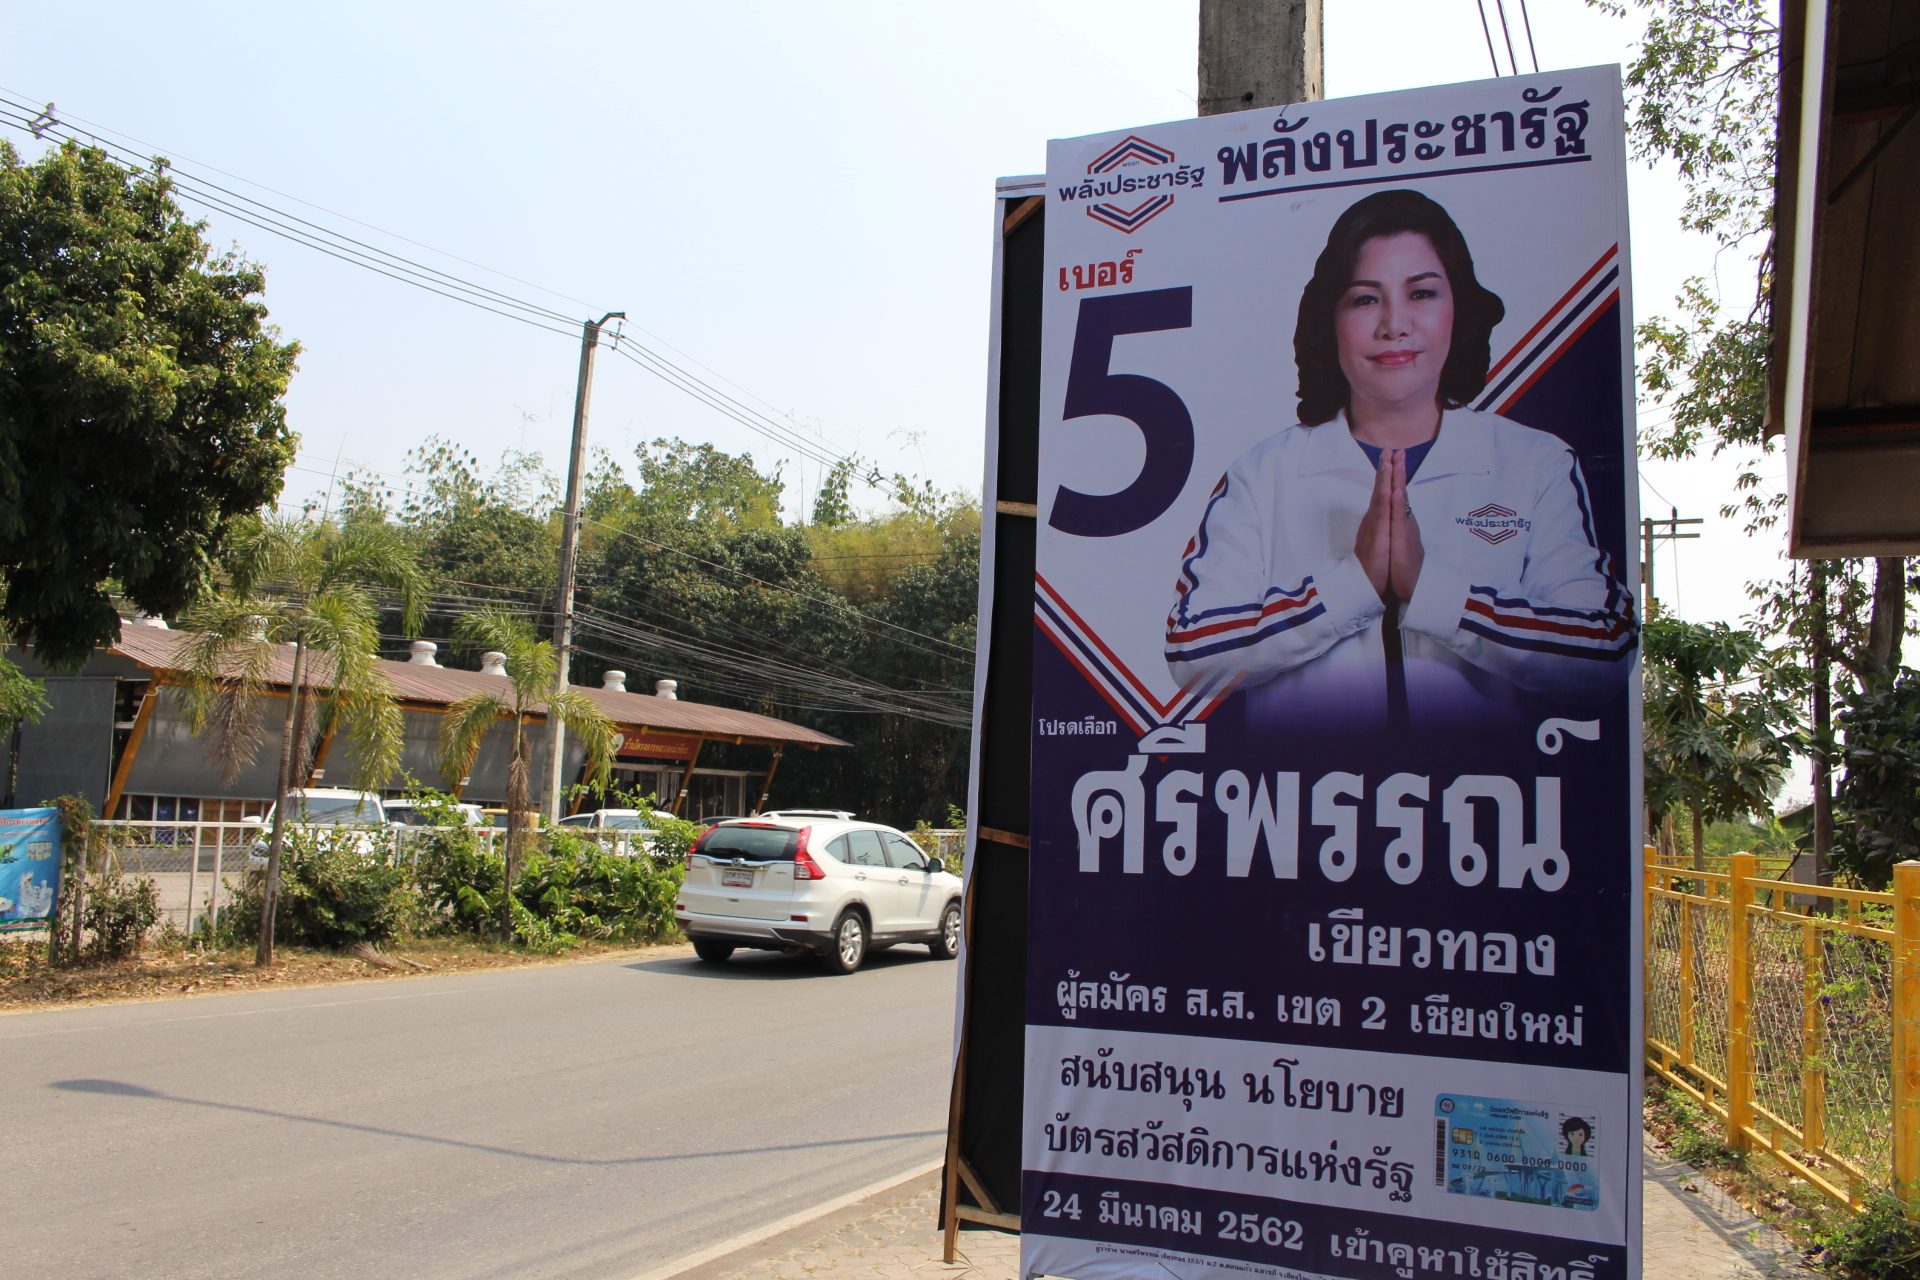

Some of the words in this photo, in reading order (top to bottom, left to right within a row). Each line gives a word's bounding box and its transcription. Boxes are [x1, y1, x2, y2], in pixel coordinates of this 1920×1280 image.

[1217, 86, 1591, 186] พลังประชารัฐ
[1059, 165, 1205, 201] พลังประชารัฐ
[1058, 248, 1142, 291] เบอร์
[1048, 285, 1195, 537] 5
[1455, 517, 1531, 532] พลังประชารัฐ
[1038, 715, 1117, 736] โปรดเลือก
[1071, 717, 1600, 893] ศรีพรรณ์
[1308, 907, 1556, 976] เขียวทอง
[1057, 969, 1167, 1021] ผู้สมัคร
[1186, 986, 1254, 1020] ส.ส.
[1277, 995, 1341, 1027] เขต
[1361, 996, 1387, 1030] 2
[1410, 995, 1582, 1046] เชียงใหม่
[1060, 1048, 1226, 1113] สนับสนุน
[1243, 1058, 1405, 1119] นโยบาย
[1044, 1112, 1415, 1203] บัตรสวัสดิการแห่งรัฐ
[1452, 1149, 1480, 1160] 9310
[1487, 1152, 1515, 1164] 0600
[1522, 1156, 1551, 1168] 0000
[1558, 1160, 1587, 1172] 0000
[1043, 1189, 1082, 1220] 24
[1098, 1190, 1201, 1235] มีนาคม
[1217, 1210, 1304, 1251] 2562
